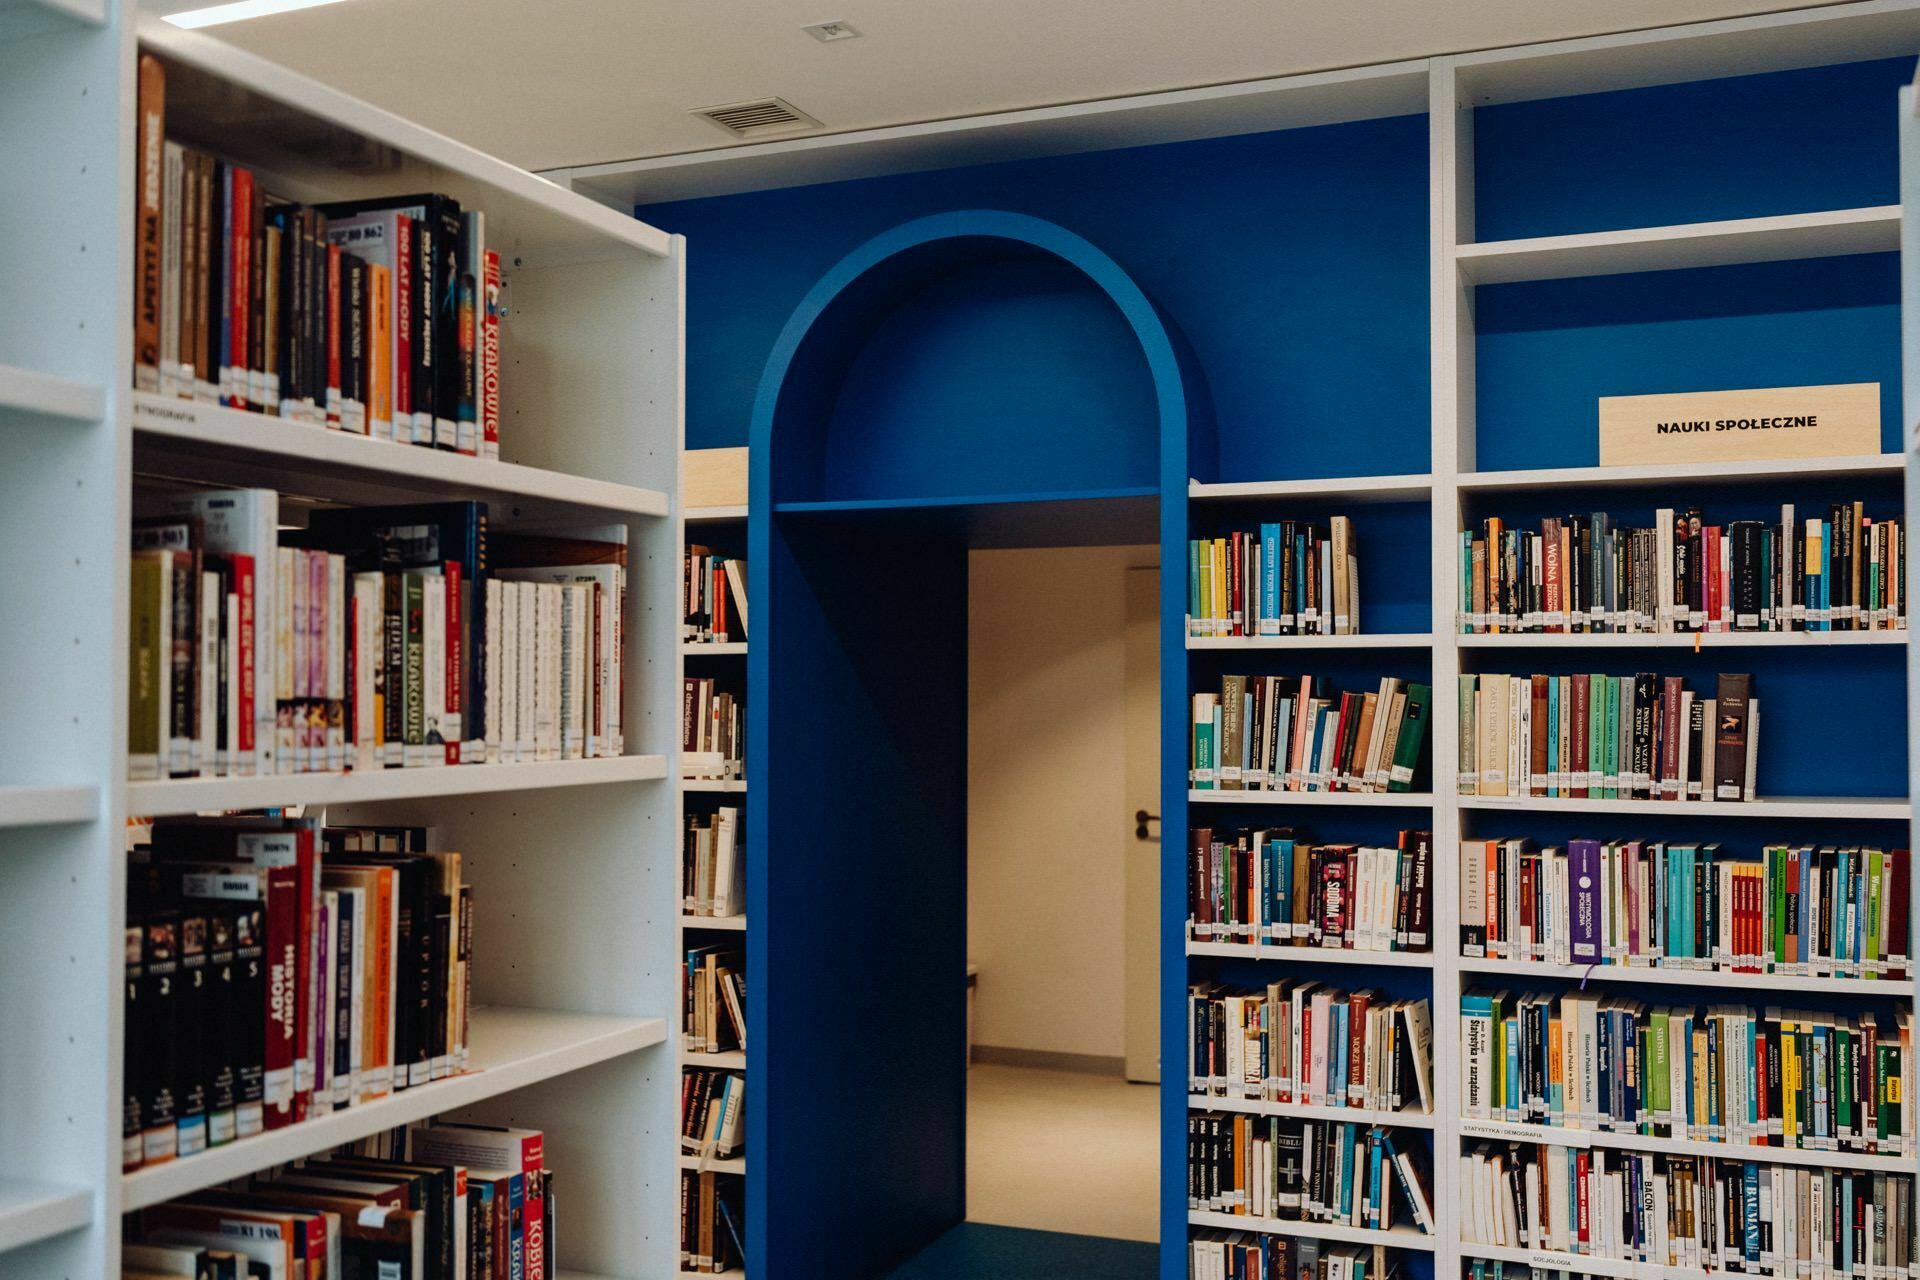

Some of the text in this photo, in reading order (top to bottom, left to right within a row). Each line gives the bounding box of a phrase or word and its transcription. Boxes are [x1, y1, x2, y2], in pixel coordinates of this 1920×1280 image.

[145, 111, 160, 212] JEDZENIE
[423, 230, 431, 254] 100
[144, 216, 157, 324] APETYT NA
[423, 258, 431, 279] LAT
[400, 225, 409, 342] 100 LAT MODY
[423, 281, 431, 316] MODY
[485, 322, 499, 435] KRAKOWIE
[1656, 415, 1817, 434] NAUKI SPOŁECZNE
[1547, 544, 1558, 582] WOJNA
[1642, 707, 1650, 736] ZIELIŃSKI
[1416, 841, 1425, 861] wojna
[1416, 865, 1425, 888] Kościół
[1468, 858, 1477, 884] DRUGA
[1327, 881, 1340, 918] SODOMA
[1871, 875, 1880, 897] Wiedza
[1788, 893, 1796, 934] Polityka społeczna
[194, 970, 202, 987] 3
[222, 966, 231, 982] 4
[249, 962, 258, 977] 5
[130, 983, 136, 1000] 1
[160, 977, 170, 995] 2
[271, 964, 284, 1023] MODY
[283, 944, 295, 1040] HISTORIA
[1467, 1019, 1481, 1056] Statystyka
[1656, 1027, 1665, 1064] STATYSTYKA
[1352, 1036, 1360, 1086] MORZE WIAR
[1599, 1046, 1608, 1072] Demografia
[1278, 1138, 1302, 1146] BIBLI
[1464, 1126, 1542, 1138] STATYSTYKA DEMOGRAFIA
[1644, 1181, 1653, 1211] BACON
[1747, 1186, 1758, 1240] BAUMAN
[528, 1218, 542, 1280] KOBIE
[1533, 1256, 1572, 1266] SOCJOLOGIA
